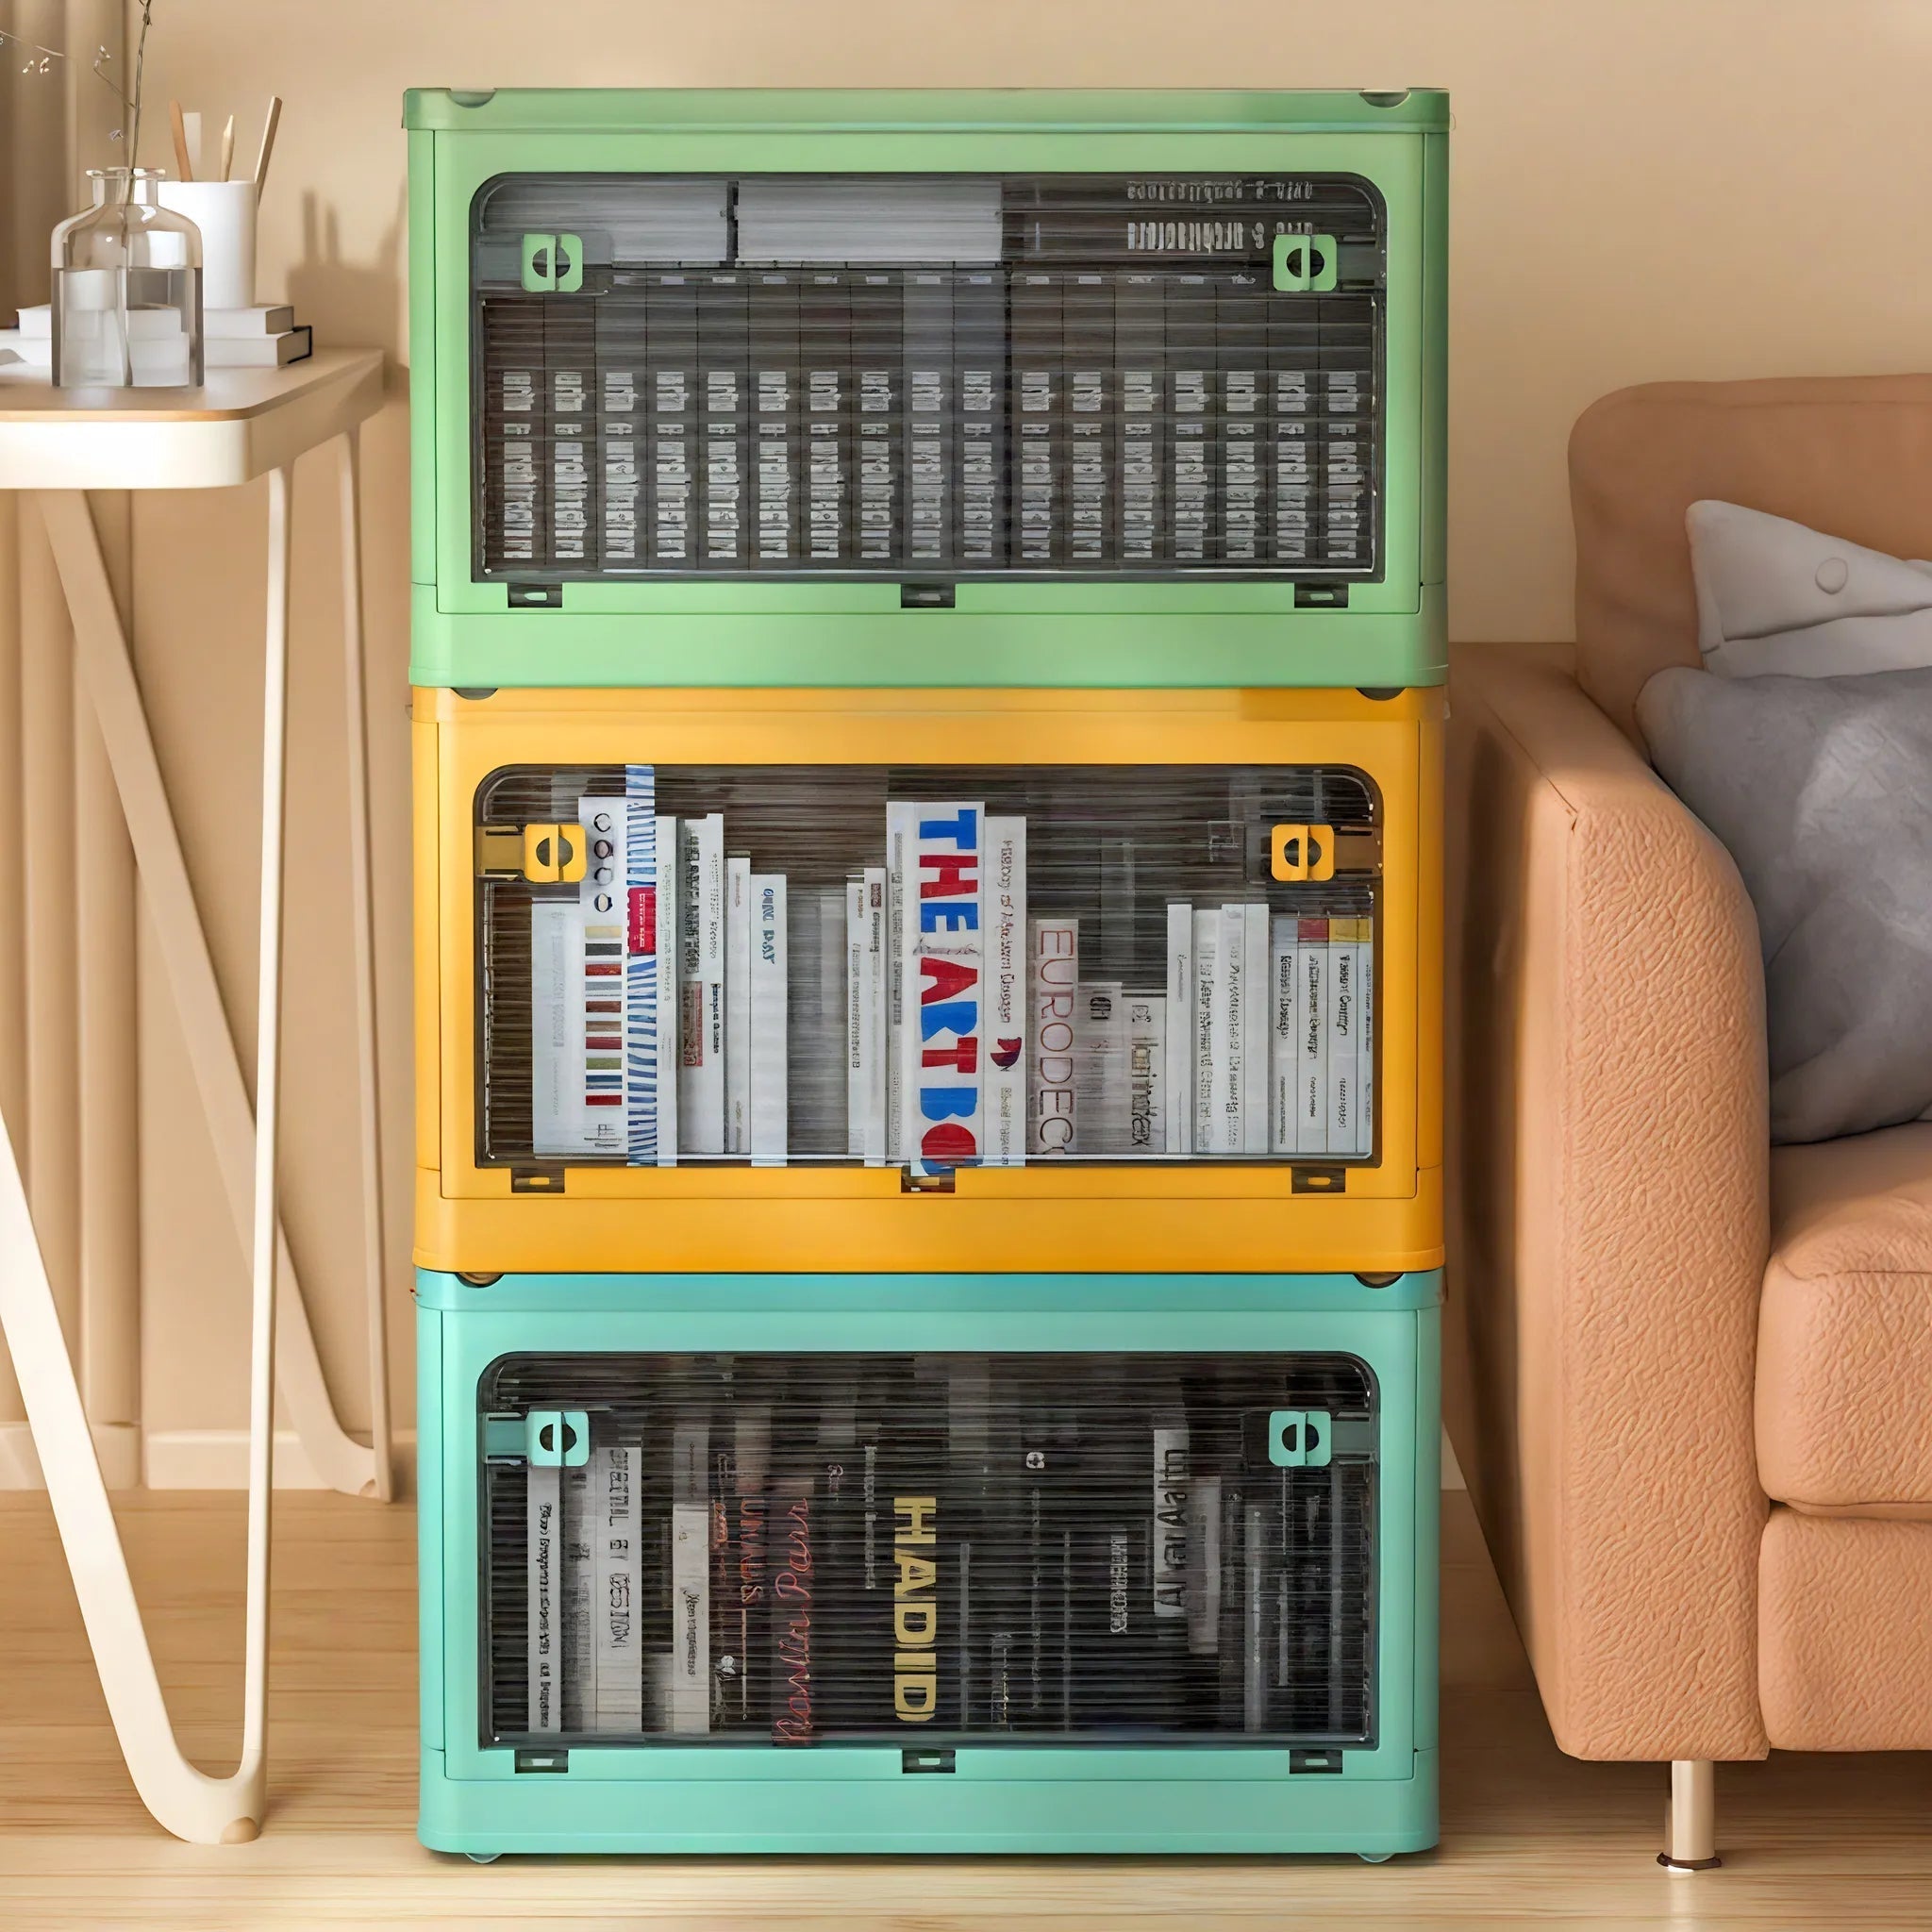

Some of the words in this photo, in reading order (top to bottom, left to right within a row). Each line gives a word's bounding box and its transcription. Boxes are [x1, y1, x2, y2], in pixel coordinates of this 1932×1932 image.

[920, 809, 979, 932] THE
[921, 958, 977, 1074] ART
[1040, 930, 1074, 1154] EURODEC
[917, 1088, 977, 1175] BO
[894, 1497, 936, 1722] HADID
